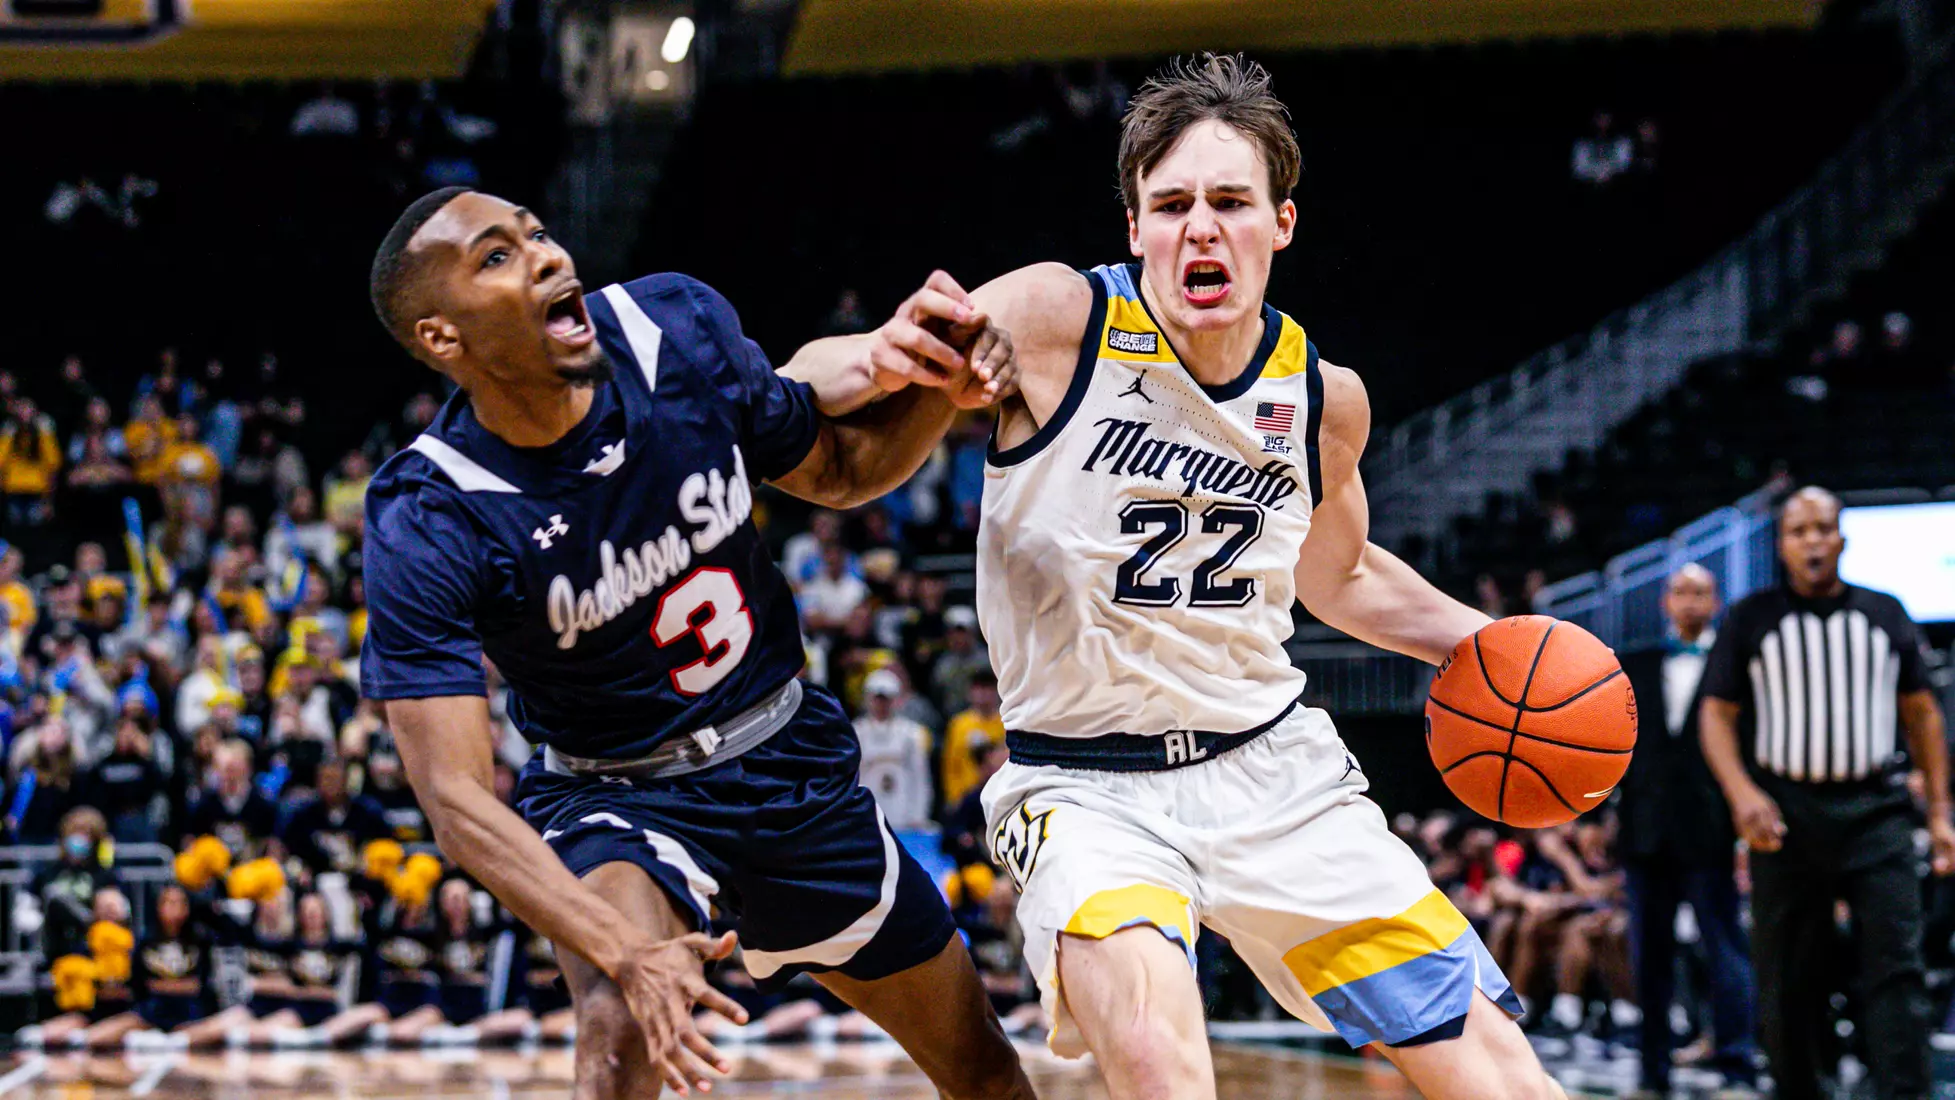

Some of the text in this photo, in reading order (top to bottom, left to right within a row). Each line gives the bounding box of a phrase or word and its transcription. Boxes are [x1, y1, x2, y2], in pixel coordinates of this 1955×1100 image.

[1109, 338, 1156, 352] CHANGE
[1082, 417, 1298, 512] Marquette
[547, 525, 691, 649] Jackson
[1113, 500, 1265, 607] 22
[650, 565, 754, 696] 3
[1164, 730, 1208, 765] AL
